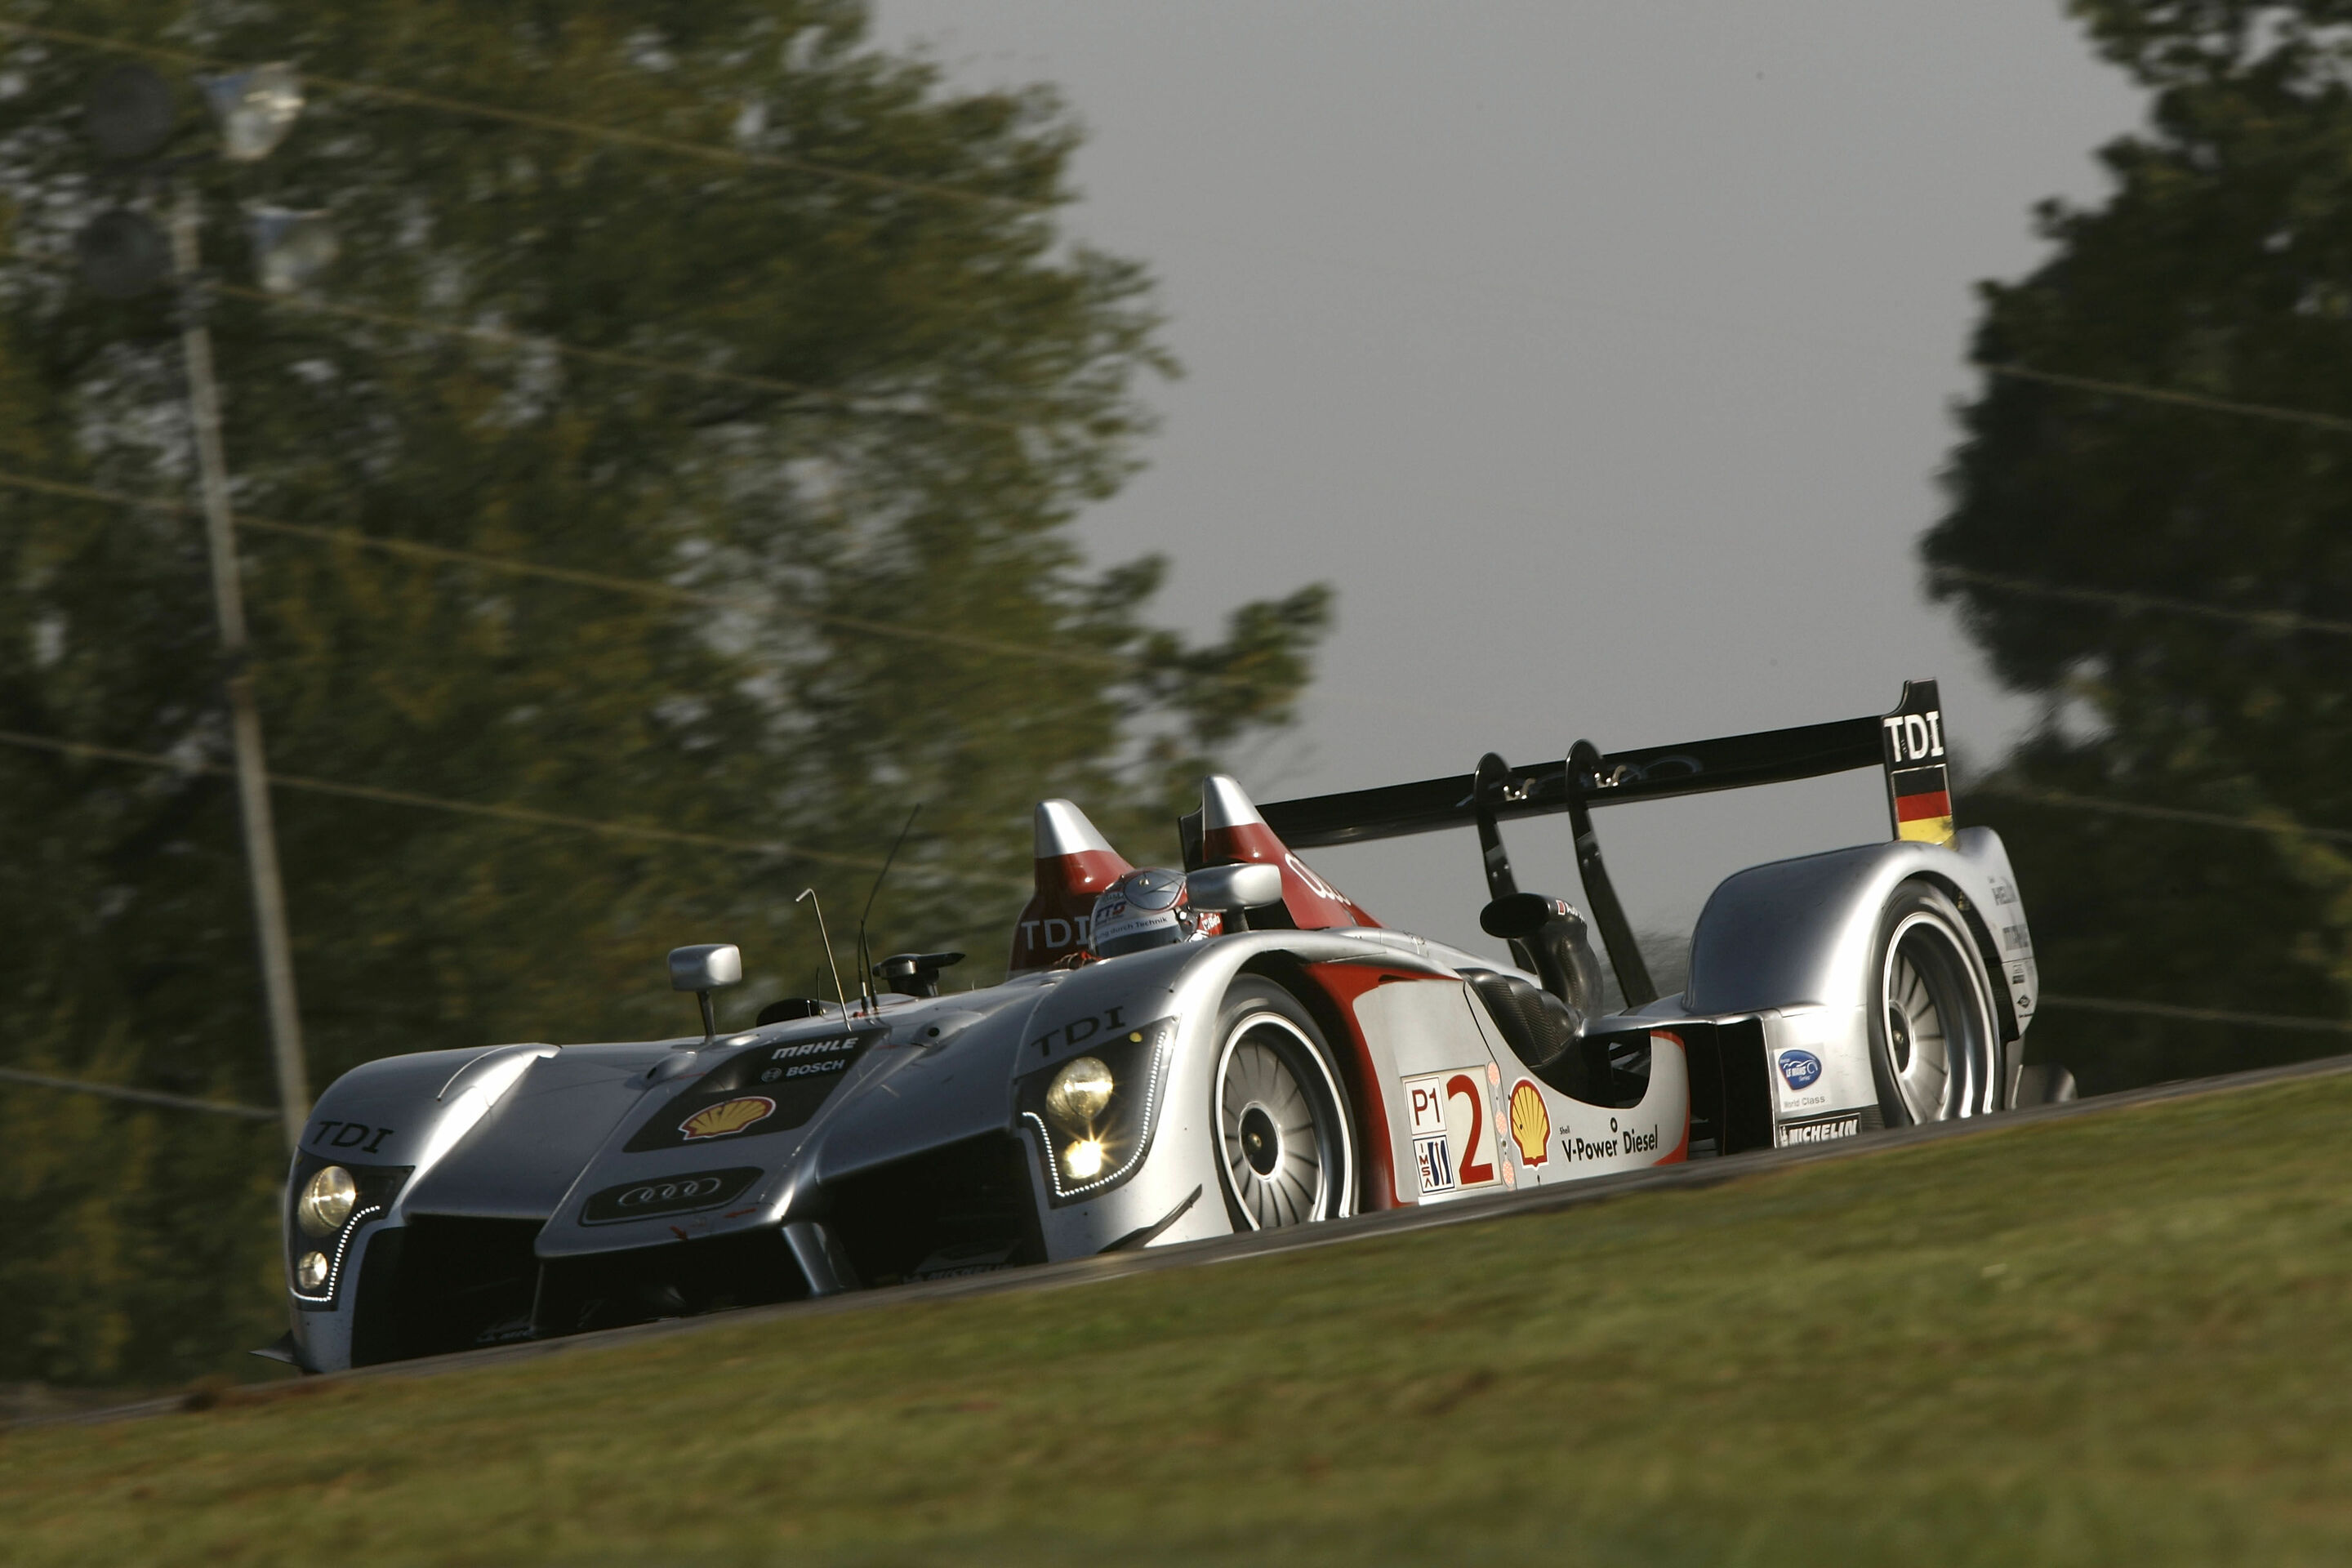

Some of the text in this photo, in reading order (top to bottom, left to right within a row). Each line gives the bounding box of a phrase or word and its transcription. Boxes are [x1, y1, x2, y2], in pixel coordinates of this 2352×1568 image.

[1883, 710, 1944, 762] TDI
[1021, 915, 1090, 951] TDI
[1111, 924, 1134, 935] durch
[1135, 916, 1168, 929] Technik
[771, 1037, 858, 1060] MAHLE
[1031, 1005, 1126, 1058] TDI
[786, 1059, 845, 1077] BOSCH
[1412, 1088, 1440, 1126] P1
[1802, 1095, 1826, 1106] Class
[312, 1120, 394, 1155] TDI
[1446, 1074, 1494, 1185] 2
[1559, 1125, 1570, 1135] Shell
[1561, 1124, 1658, 1162] V-Power Diesel
[1788, 1119, 1858, 1145] MICHELIN
